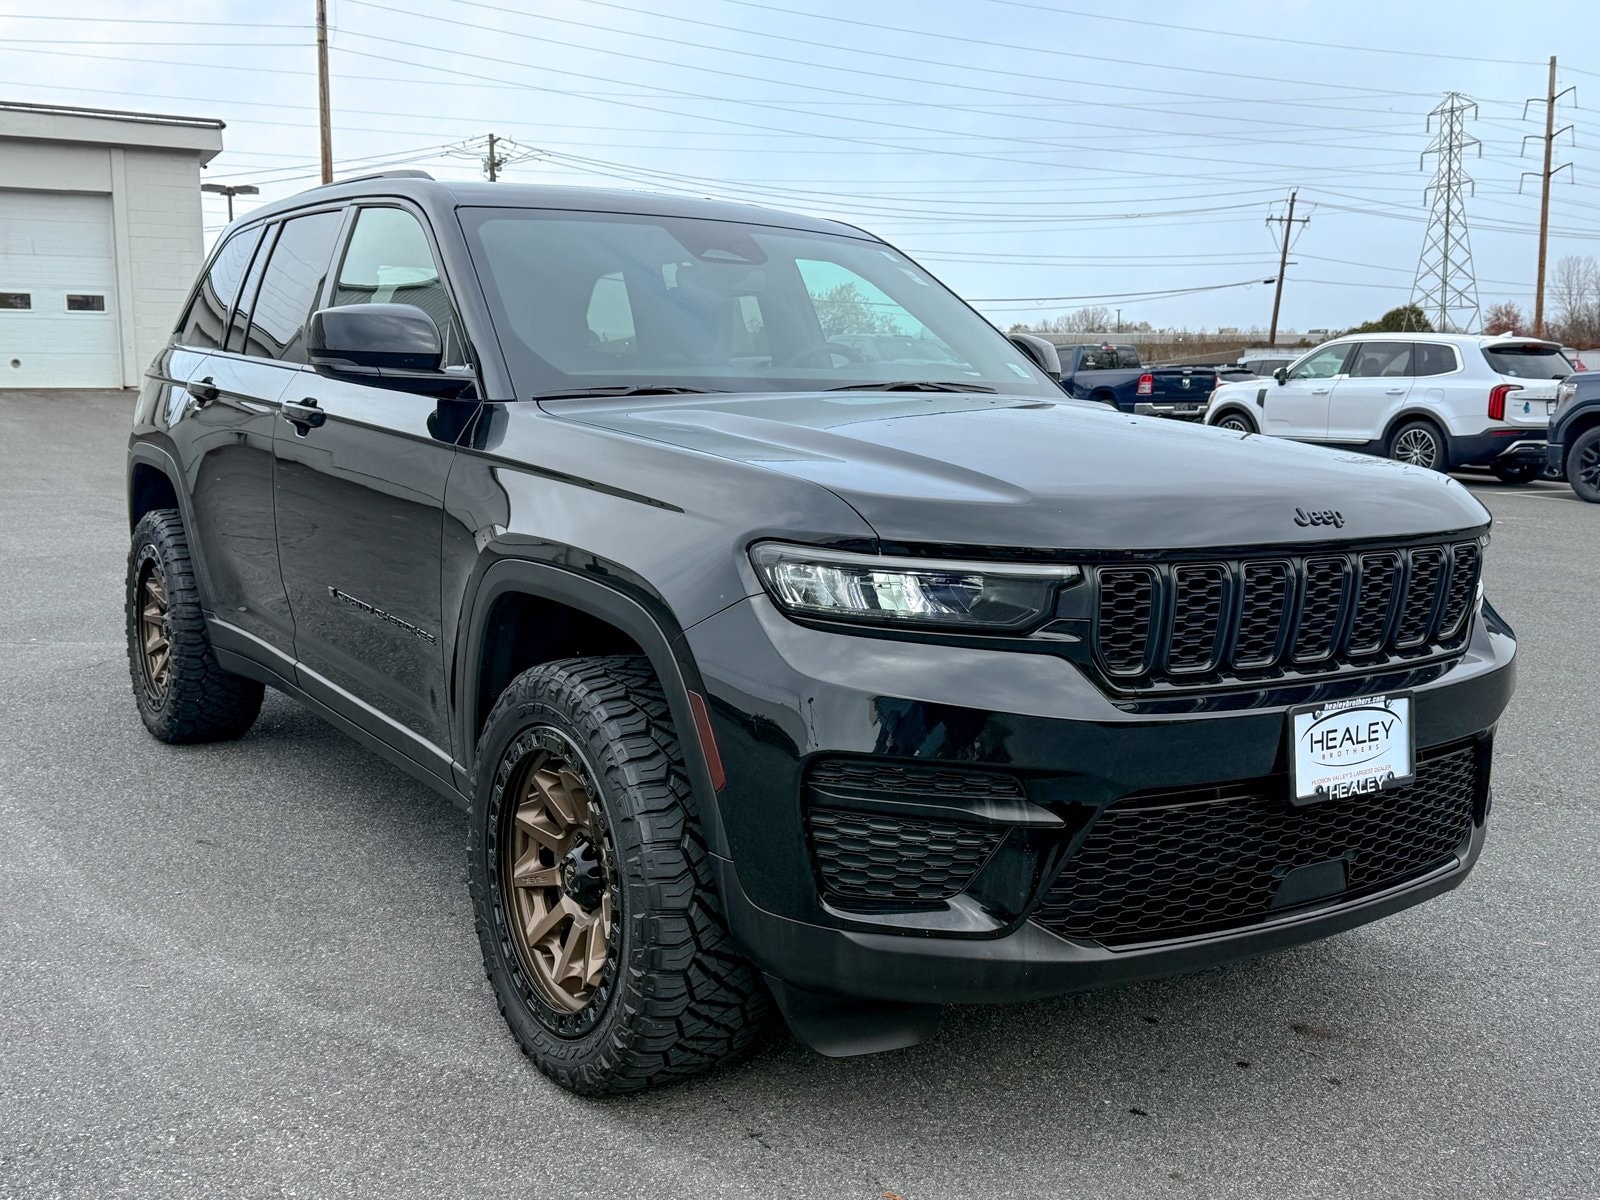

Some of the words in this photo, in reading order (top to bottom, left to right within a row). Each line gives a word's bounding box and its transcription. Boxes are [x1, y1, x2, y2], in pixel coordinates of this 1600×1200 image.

[1294, 506, 1345, 529] Jeep
[1324, 695, 1386, 711] healeybrothers.com
[1310, 719, 1394, 753] HEALEY
[1322, 744, 1380, 760] BROTHERS
[1312, 777, 1331, 786] HUDSON
[1353, 767, 1374, 778] LARGEST
[1374, 764, 1392, 774] DEALER
[1328, 775, 1385, 800] HEALEY
